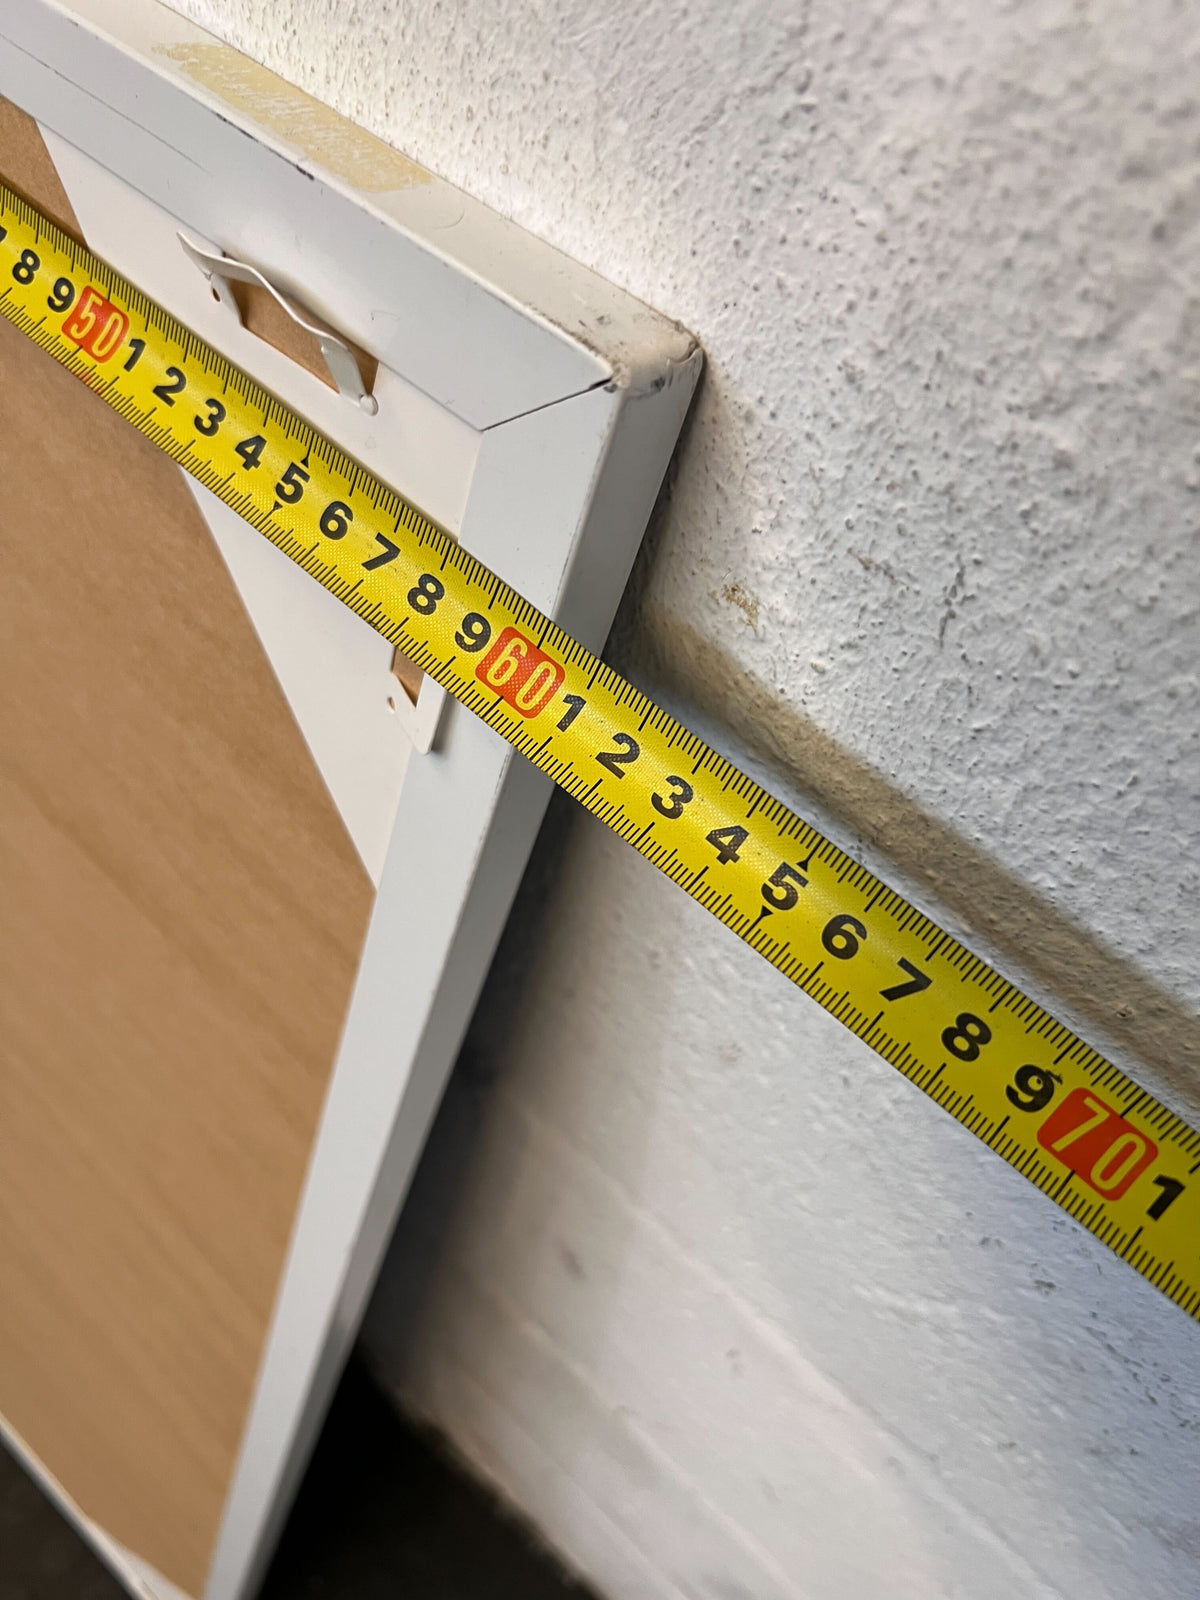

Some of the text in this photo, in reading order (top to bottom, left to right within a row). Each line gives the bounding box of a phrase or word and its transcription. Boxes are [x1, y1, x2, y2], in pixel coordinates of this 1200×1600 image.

[12, 249, 1186, 1221] 8 9 50 1 2 3 4 5 6 7 8 9 60 1 2 3 4 5 6 7 8 9 70 1
